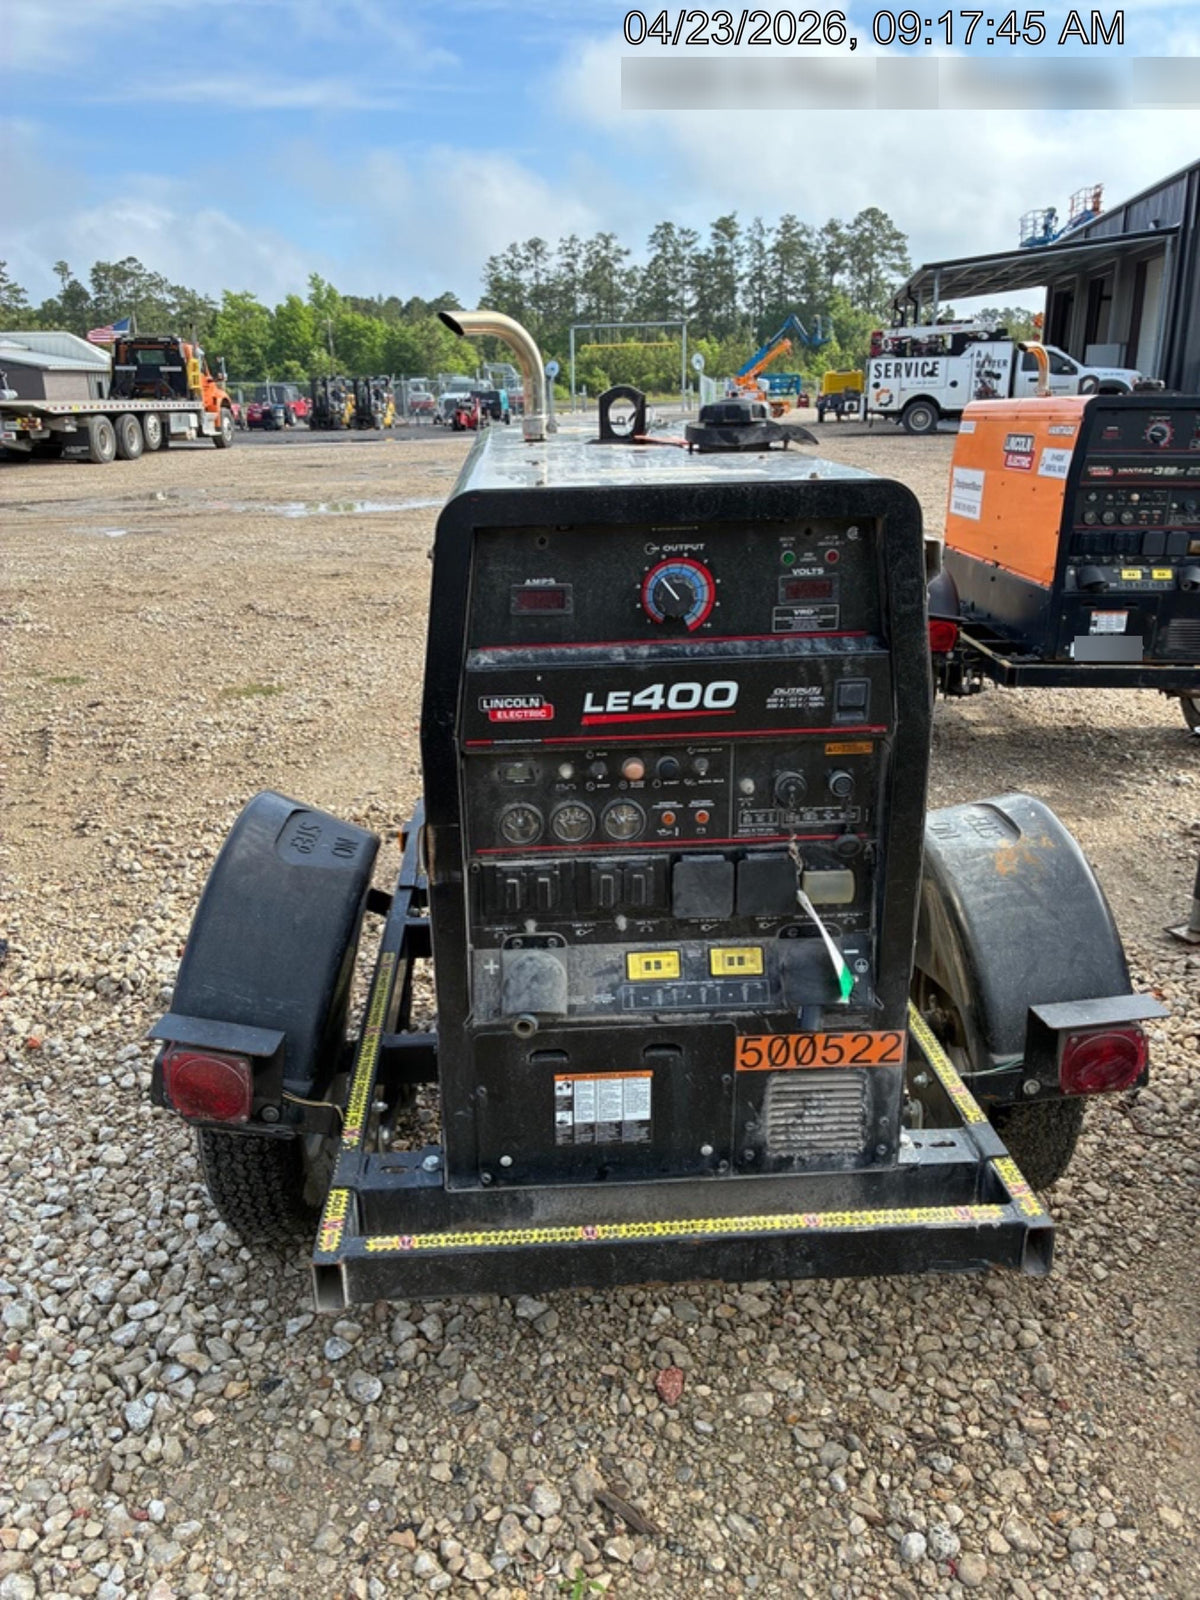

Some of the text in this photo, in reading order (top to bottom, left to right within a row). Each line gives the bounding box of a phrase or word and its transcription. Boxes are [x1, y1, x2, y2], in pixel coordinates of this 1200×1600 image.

[873, 360, 940, 379] SERVICE
[662, 543, 705, 552] OUTPUT
[792, 567, 824, 576] VOLTS
[524, 578, 556, 586] AMPS
[583, 680, 739, 713] LE400
[482, 697, 541, 708] LINCOLN
[496, 709, 547, 719] ELECTRIC
[739, 1032, 902, 1069] 500522
[417, 1237, 442, 1247] DO
[445, 1235, 479, 1245] NOT
[481, 1232, 534, 1243] STAND
[537, 1229, 577, 1241] HERE
[600, 1227, 623, 1236] NE
[625, 1225, 656, 1234] PAS
